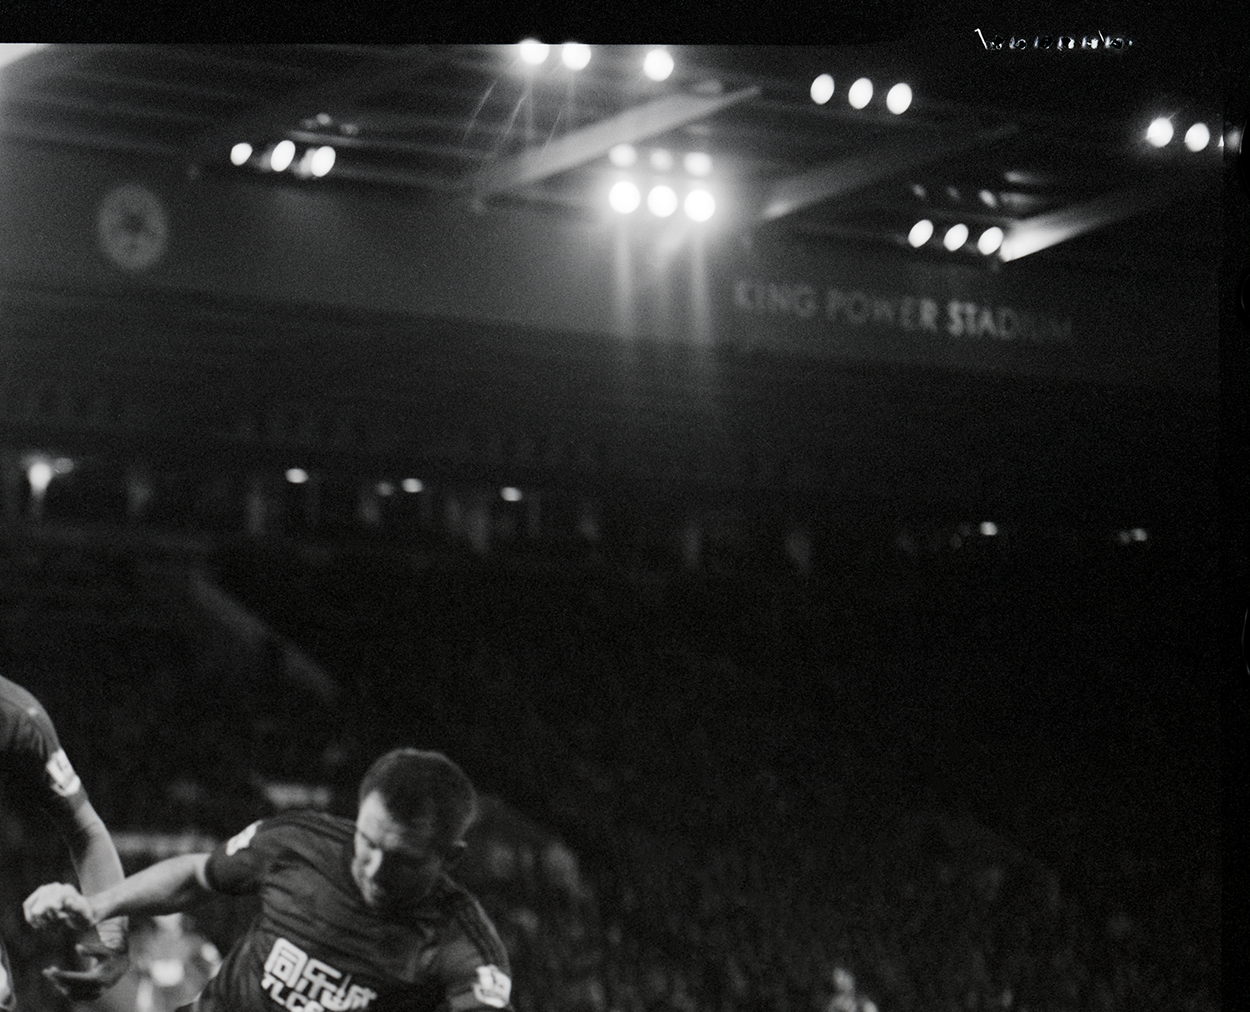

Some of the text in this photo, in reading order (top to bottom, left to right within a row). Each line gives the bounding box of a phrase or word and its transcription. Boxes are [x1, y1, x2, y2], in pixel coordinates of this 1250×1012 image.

[734, 278, 1073, 343] KING POWER STADIUM
